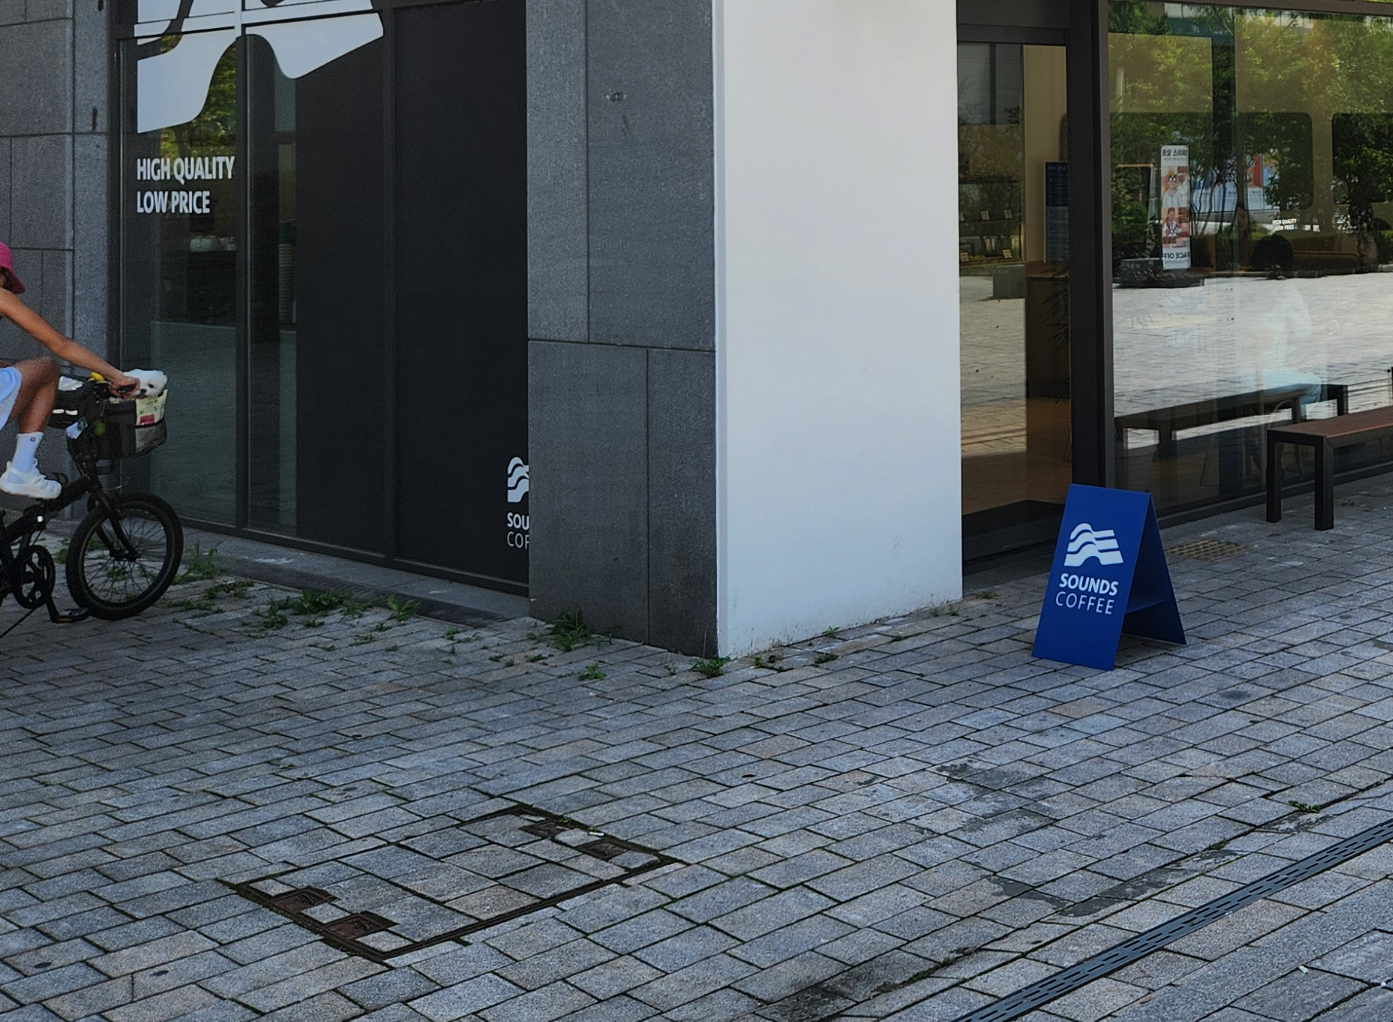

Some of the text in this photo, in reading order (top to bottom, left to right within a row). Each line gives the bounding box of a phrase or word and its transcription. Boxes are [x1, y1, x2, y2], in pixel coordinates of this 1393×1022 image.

[137, 156, 235, 185] HIGH QUALITY
[137, 190, 210, 213] LOW PRICE
[507, 512, 529, 530] SOU
[507, 531, 529, 550] COF
[1058, 573, 1119, 596] SOUNDS
[1055, 591, 1116, 615] COFFEE
